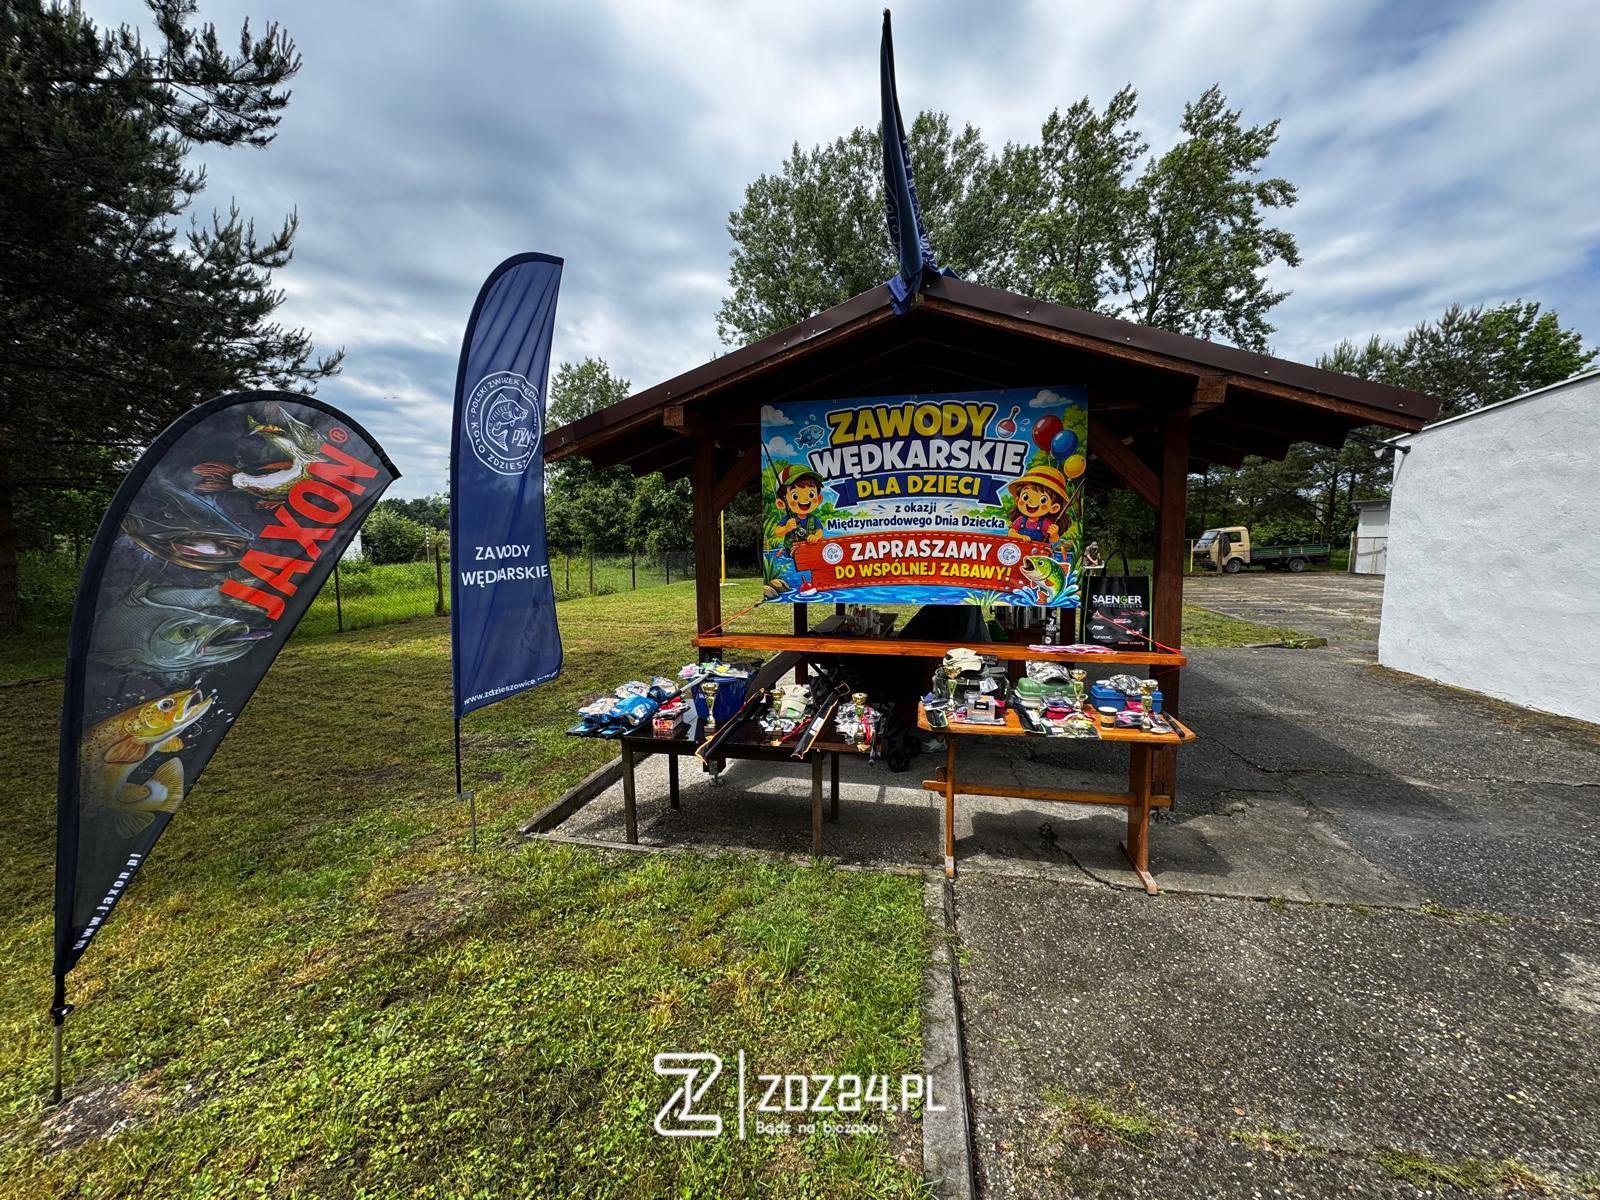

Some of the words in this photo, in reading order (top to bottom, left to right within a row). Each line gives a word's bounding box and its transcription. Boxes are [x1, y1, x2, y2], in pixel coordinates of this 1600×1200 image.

[471, 385, 489, 414] POLSKI
[828, 404, 994, 445] ZAWODY
[471, 421, 486, 454] KOŁO
[810, 439, 1027, 479] WĘDKARSKIE
[856, 477, 901, 498] DLA
[907, 475, 981, 496] DZIECI
[895, 505, 901, 513] z
[904, 502, 937, 515] okazji
[827, 515, 932, 531] Międzynarodowego
[935, 515, 959, 526] Dnia
[961, 515, 1005, 529] Dziecka
[475, 544, 531, 561] ZAWODY
[850, 539, 992, 562] ZAPRASZAMY
[835, 565, 856, 580] DO
[859, 559, 936, 578] WSPÓLNEJ
[940, 562, 1012, 582] ZABAWY!
[1092, 594, 1142, 604] SAENGER
